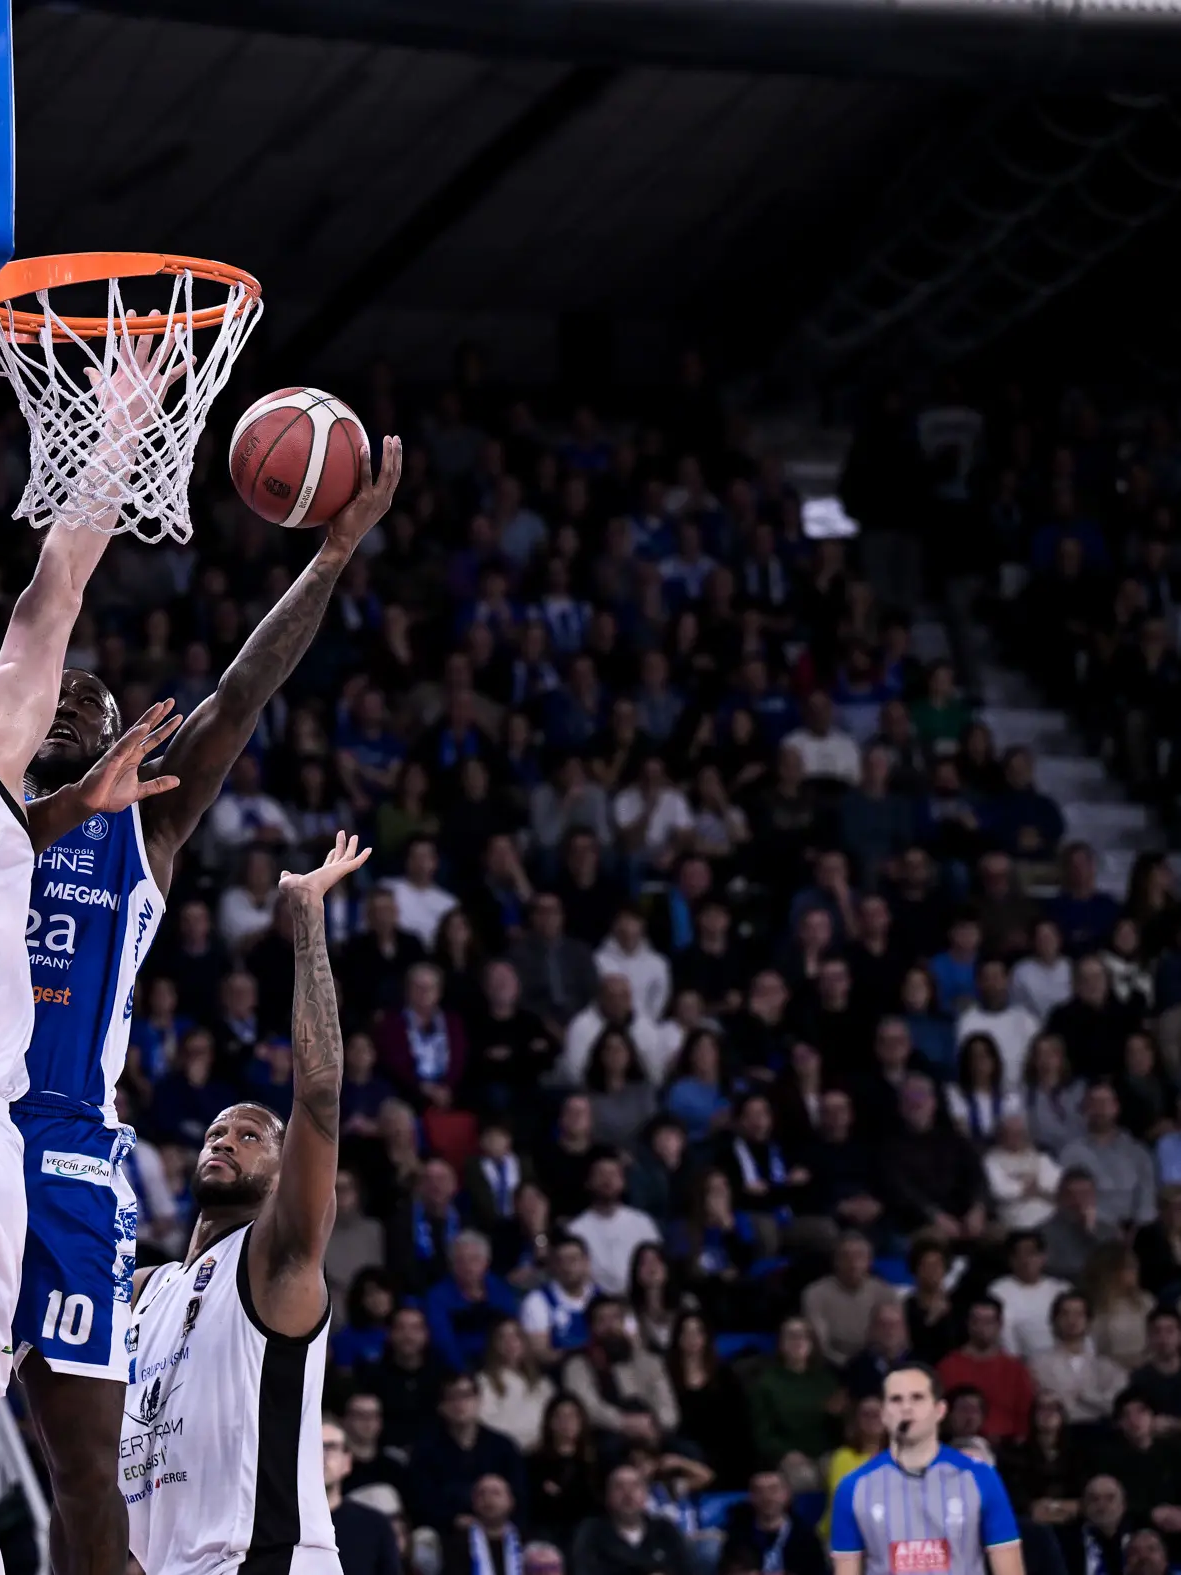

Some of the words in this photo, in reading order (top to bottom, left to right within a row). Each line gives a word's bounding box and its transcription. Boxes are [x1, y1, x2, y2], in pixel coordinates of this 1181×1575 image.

[44, 846, 95, 856] ETROLOGIA
[34, 852, 95, 875] HNE
[46, 1158, 79, 1171] VECCHI
[81, 1165, 109, 1177] ZIRONI
[41, 1289, 94, 1345] 10
[125, 1490, 146, 1505] ianz
